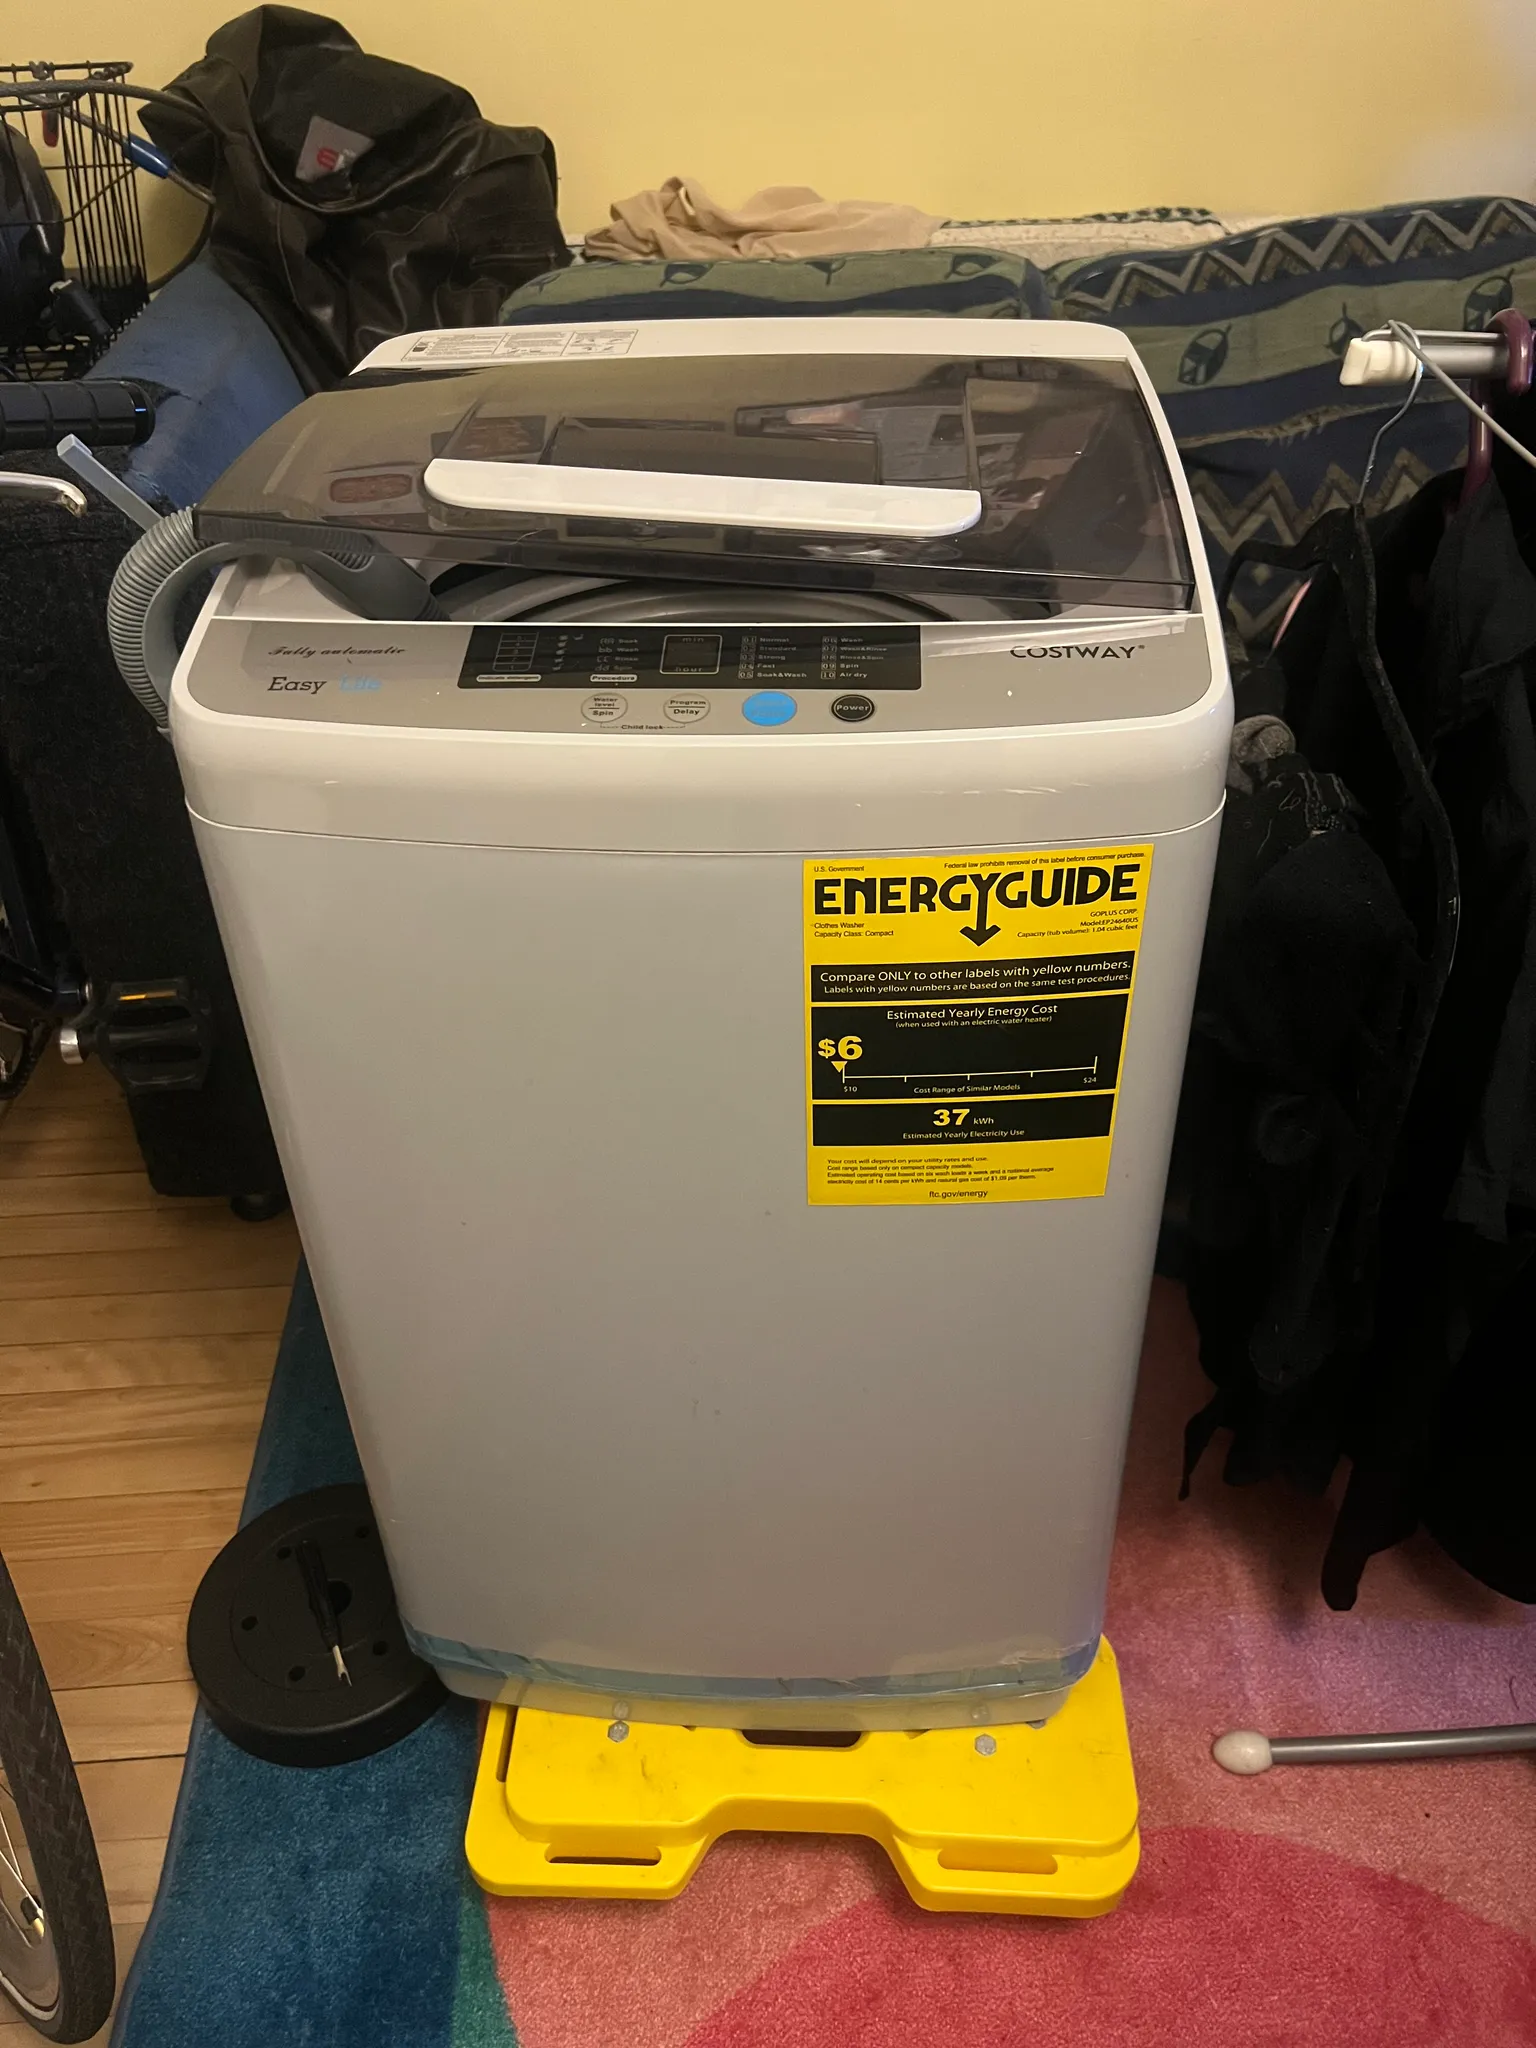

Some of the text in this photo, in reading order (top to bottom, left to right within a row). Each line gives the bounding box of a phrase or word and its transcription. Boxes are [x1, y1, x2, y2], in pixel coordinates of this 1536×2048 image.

[320, 646, 406, 655] automatic
[1010, 645, 1136, 659] COSTWAY
[267, 676, 328, 695] Easy
[979, 860, 1005, 868] prohibits
[1006, 858, 1030, 866] removal
[1086, 853, 1117, 861] consumer
[814, 863, 1141, 918] ENERGYGUIDE
[865, 930, 894, 938] Compact
[1017, 930, 1046, 938] Capacity
[820, 960, 1131, 983] Compare ONLY to other labels with yellow numbers.
[824, 973, 1131, 994] Labels with yellow numbers are based on the same test procedures.
[887, 1004, 1058, 1020] Estimated Yearly Energy Cost
[921, 1020, 940, 1028] used
[941, 1019, 959, 1027] with
[971, 1018, 1000, 1026] electric
[1001, 1017, 1023, 1025] water
[817, 1035, 863, 1060] $6
[1083, 1076, 1097, 1084] $24
[932, 1086, 956, 1094] Range
[932, 1108, 995, 1127] 37 kWh
[902, 1132, 942, 1140] Estimated
[944, 1131, 969, 1140] Yearly
[969, 1129, 1009, 1138] Electricity
[929, 1189, 989, 1199] ftc.gov/energy
